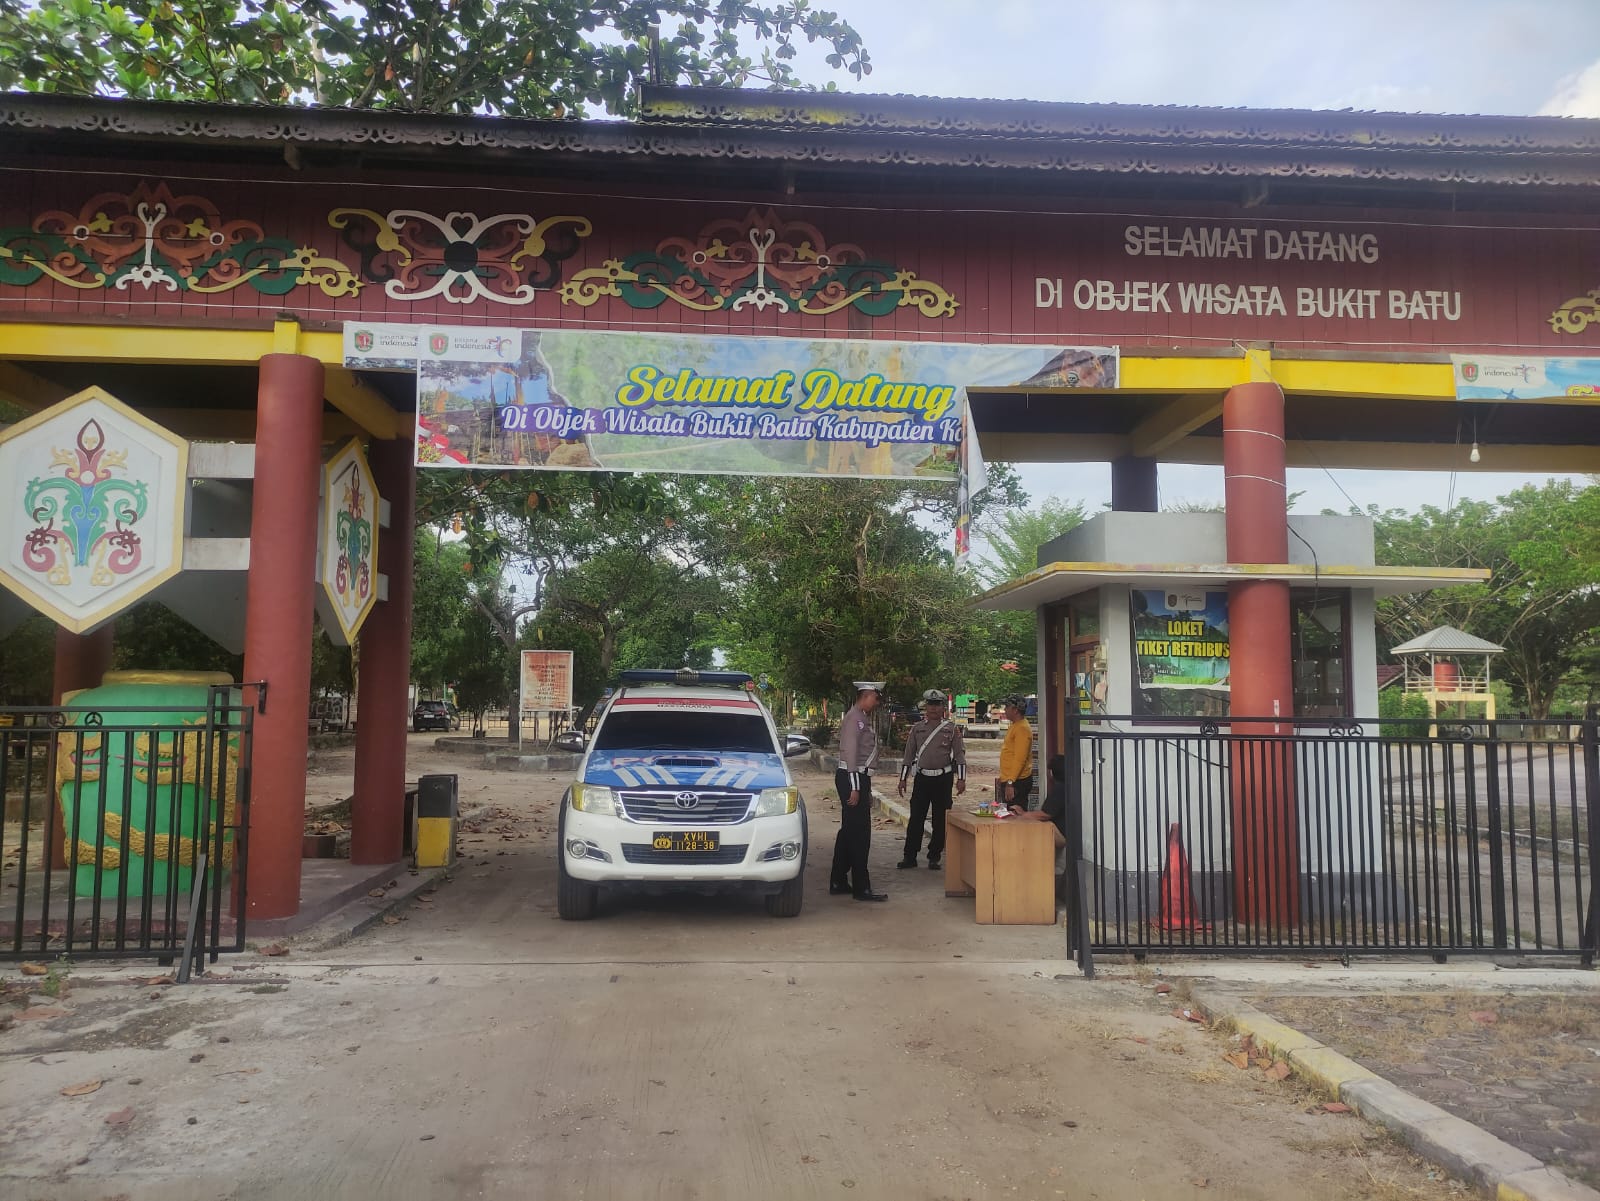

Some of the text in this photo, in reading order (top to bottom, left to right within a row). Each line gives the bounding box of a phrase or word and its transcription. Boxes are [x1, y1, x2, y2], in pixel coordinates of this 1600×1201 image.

[1124, 226, 1379, 263] SELAMAT DATANG
[1035, 278, 1462, 321] DI OBJEK WISATA BUKIT BATU
[617, 366, 956, 422] Selamat Datang
[502, 405, 529, 430] Di
[533, 406, 597, 438] Objek
[603, 408, 685, 436] Wisata
[690, 413, 753, 437] Bukit
[758, 414, 814, 438] Batu
[816, 415, 933, 446] Kabupaten
[1167, 620, 1204, 636] LOKET
[1137, 640, 1169, 656] TIKET
